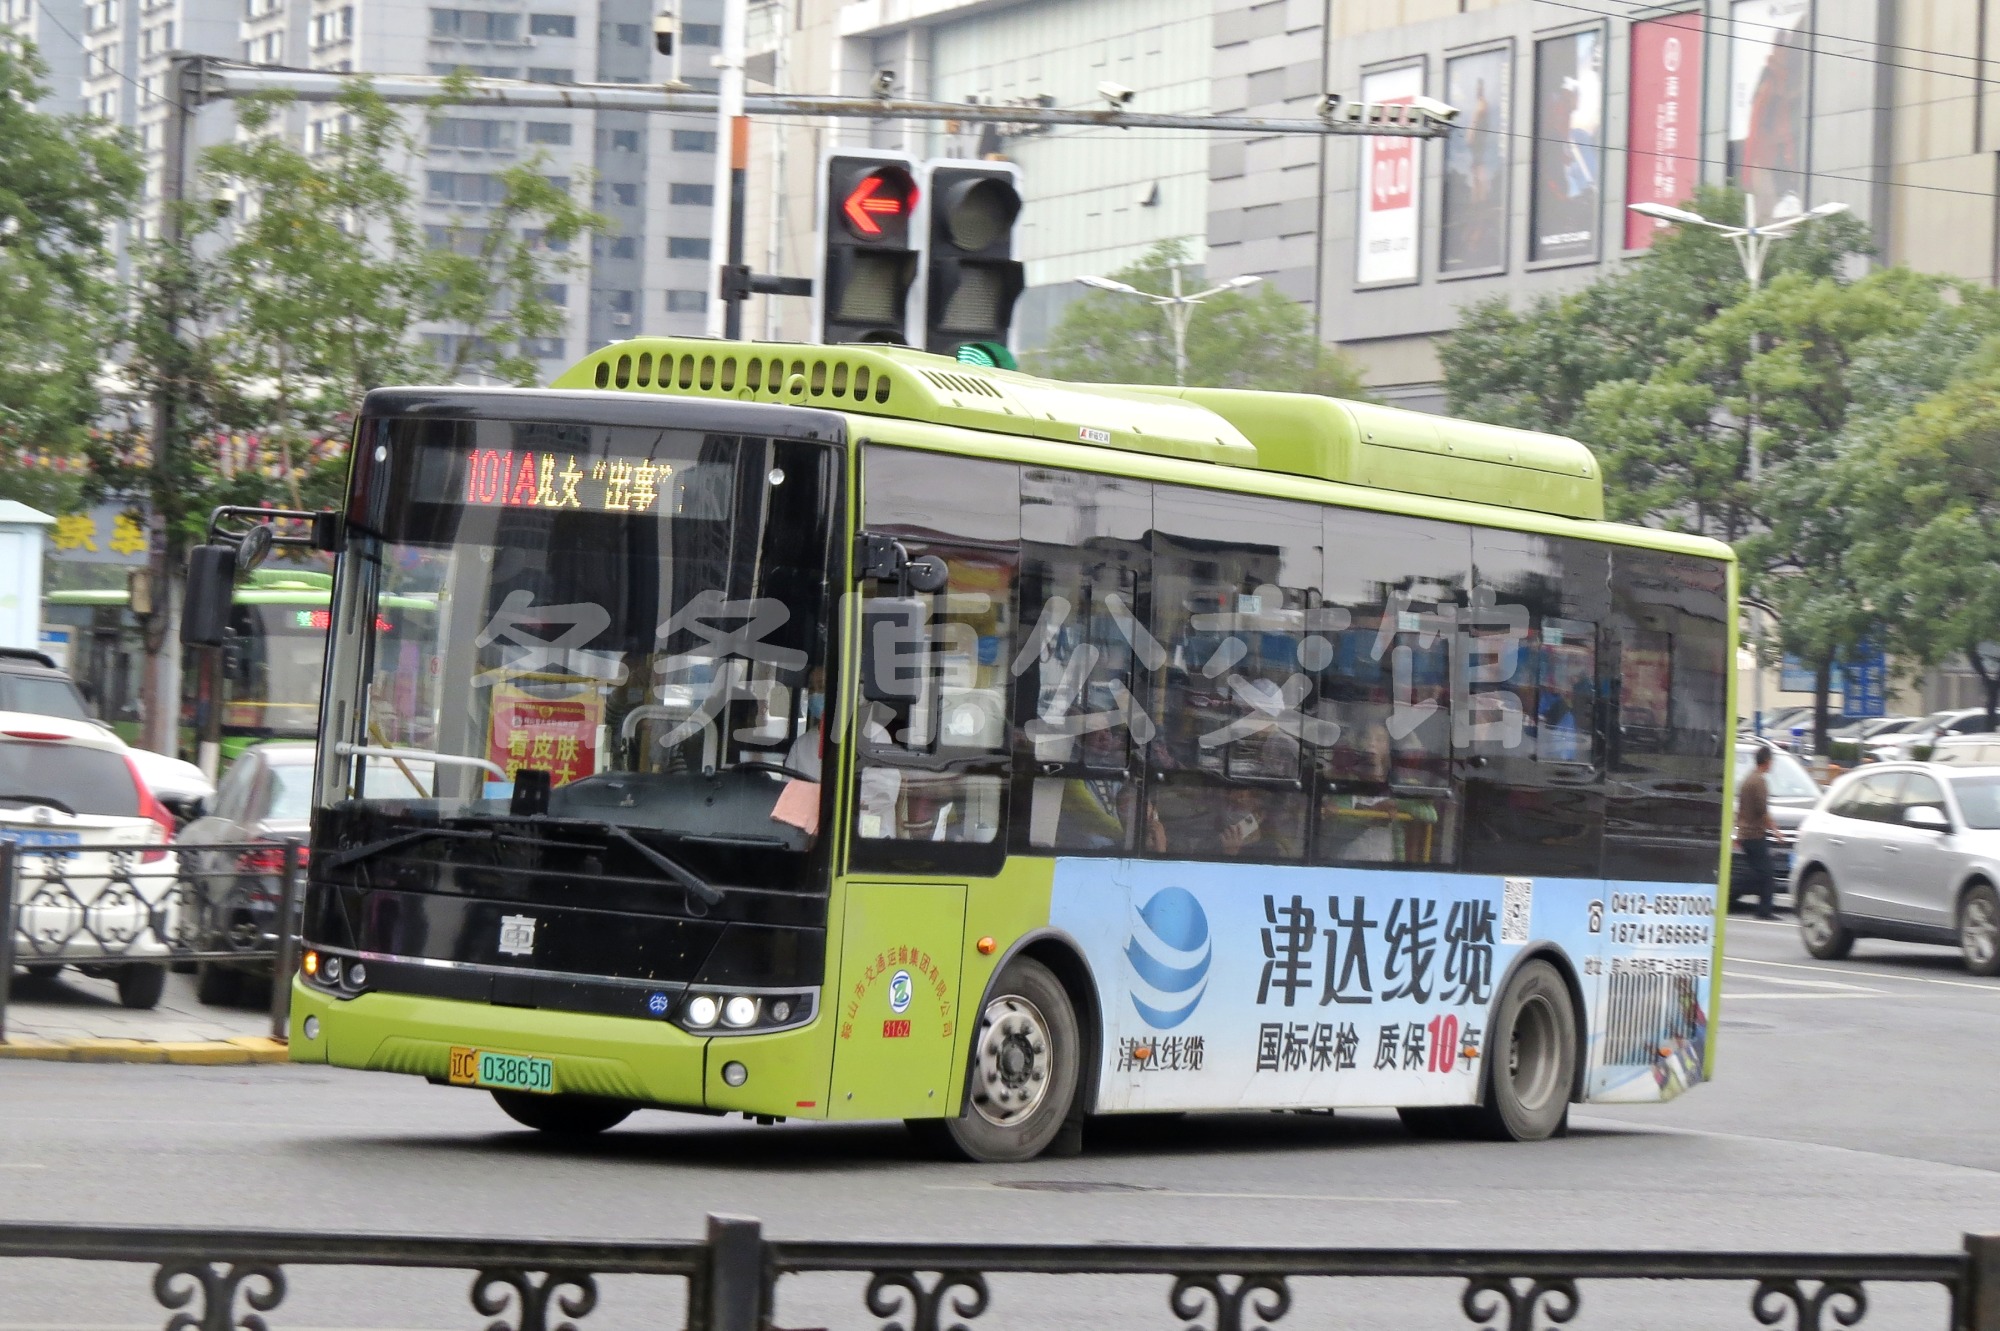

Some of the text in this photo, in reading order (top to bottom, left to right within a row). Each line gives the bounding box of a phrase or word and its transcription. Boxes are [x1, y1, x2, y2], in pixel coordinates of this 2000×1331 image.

[468, 449, 537, 505] 101A
[507, 730, 579, 762] 看皮肤
[1256, 894, 1497, 1006] 津达线缆
[841, 944, 953, 1040] 鞍山市交通运输集团有限公司
[884, 1020, 909, 1037] 3162
[1116, 1035, 1205, 1072] 津达线缆
[1256, 1014, 1482, 1073] 国标保检 质保10年
